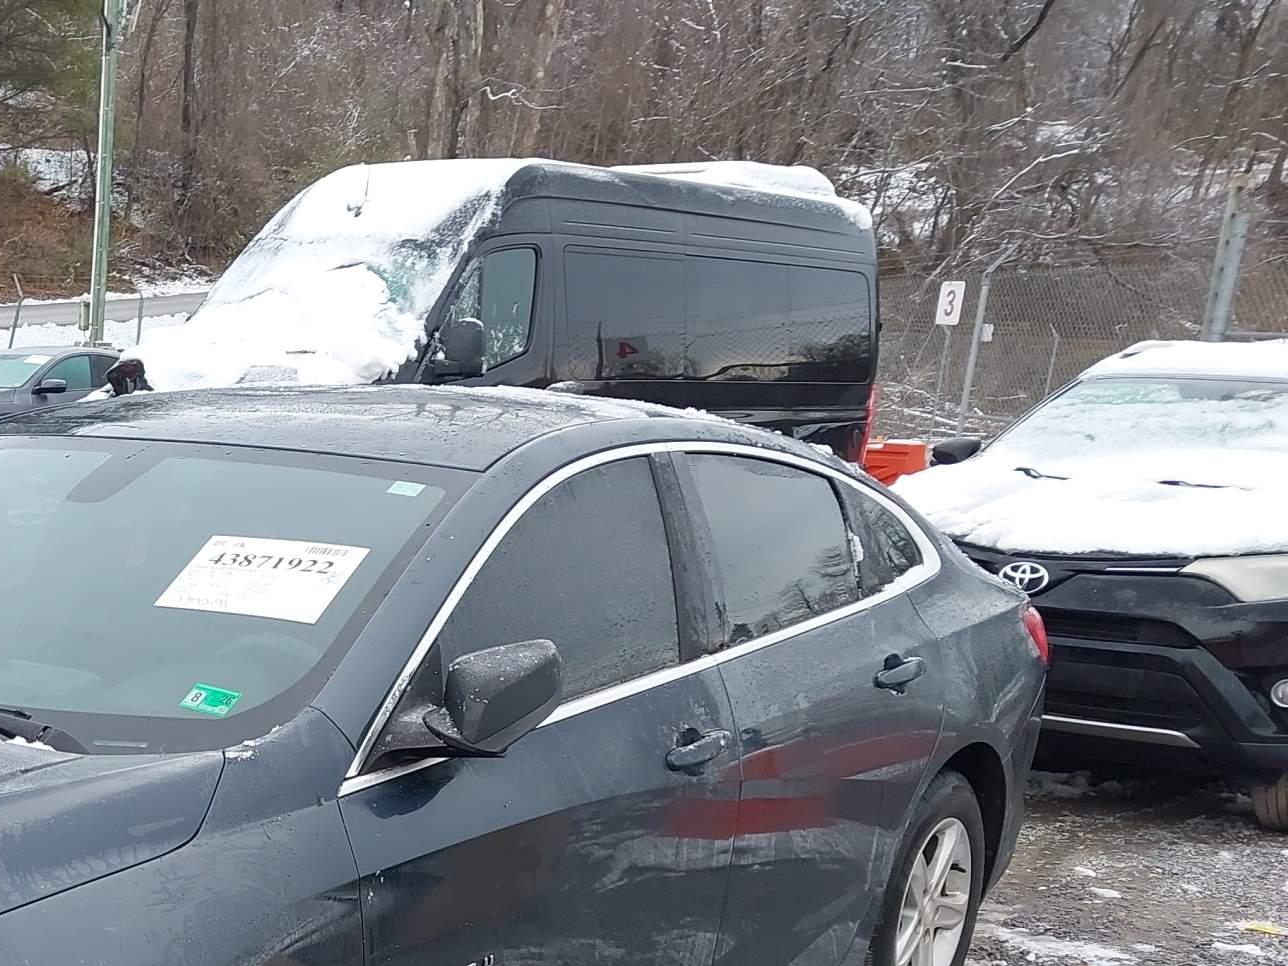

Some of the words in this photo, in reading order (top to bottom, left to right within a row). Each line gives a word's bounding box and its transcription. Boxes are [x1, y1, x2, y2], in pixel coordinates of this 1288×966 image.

[944, 289, 956, 317] 3
[209, 552, 334, 574] 43871922
[190, 692, 202, 702] 8
